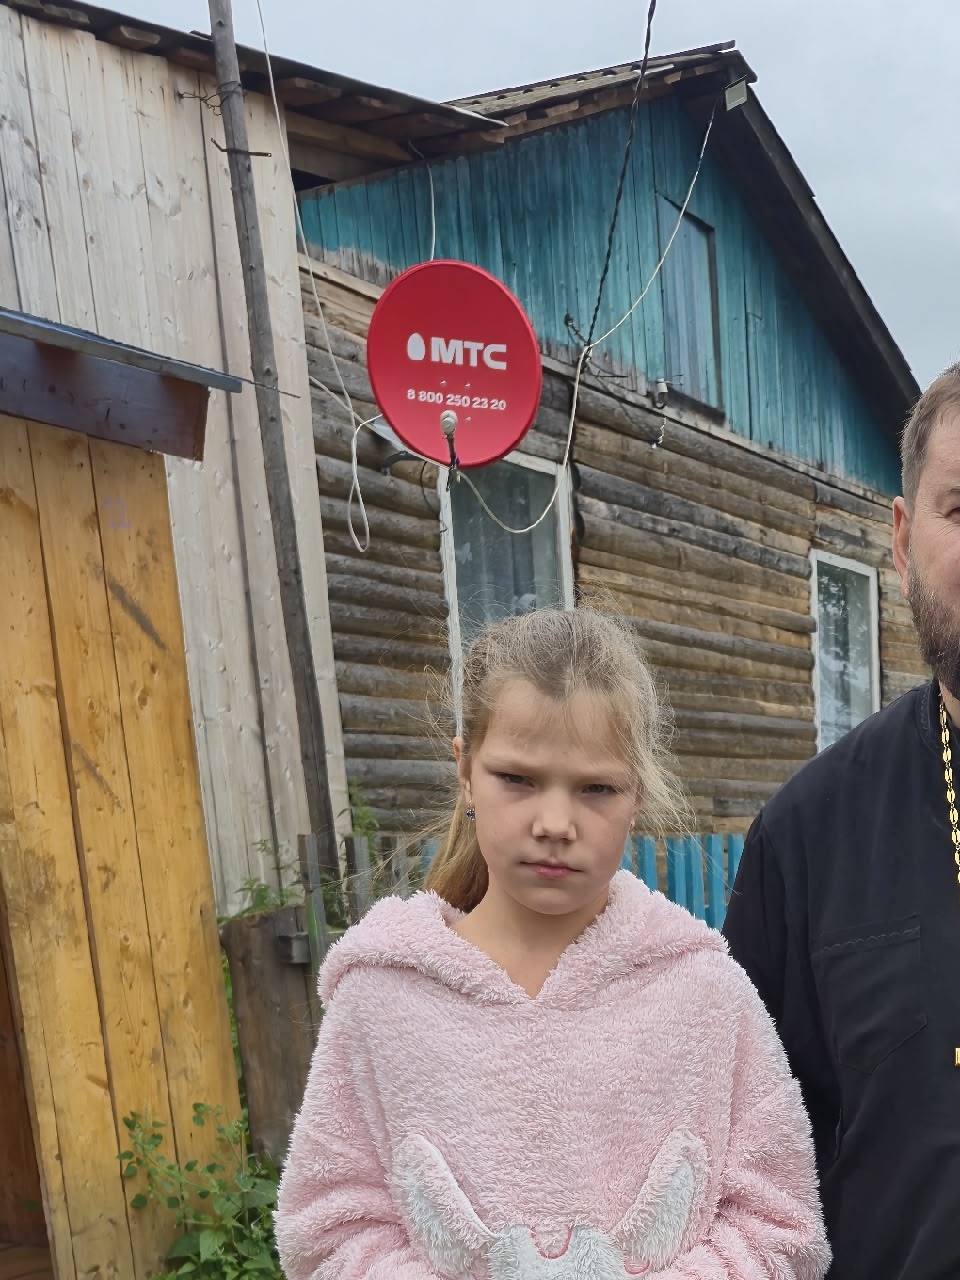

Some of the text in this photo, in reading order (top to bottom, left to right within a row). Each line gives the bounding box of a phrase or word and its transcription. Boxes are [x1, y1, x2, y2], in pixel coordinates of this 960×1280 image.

[431, 336, 507, 371] МТС
[407, 388, 507, 411] 8 800 250 23 20
